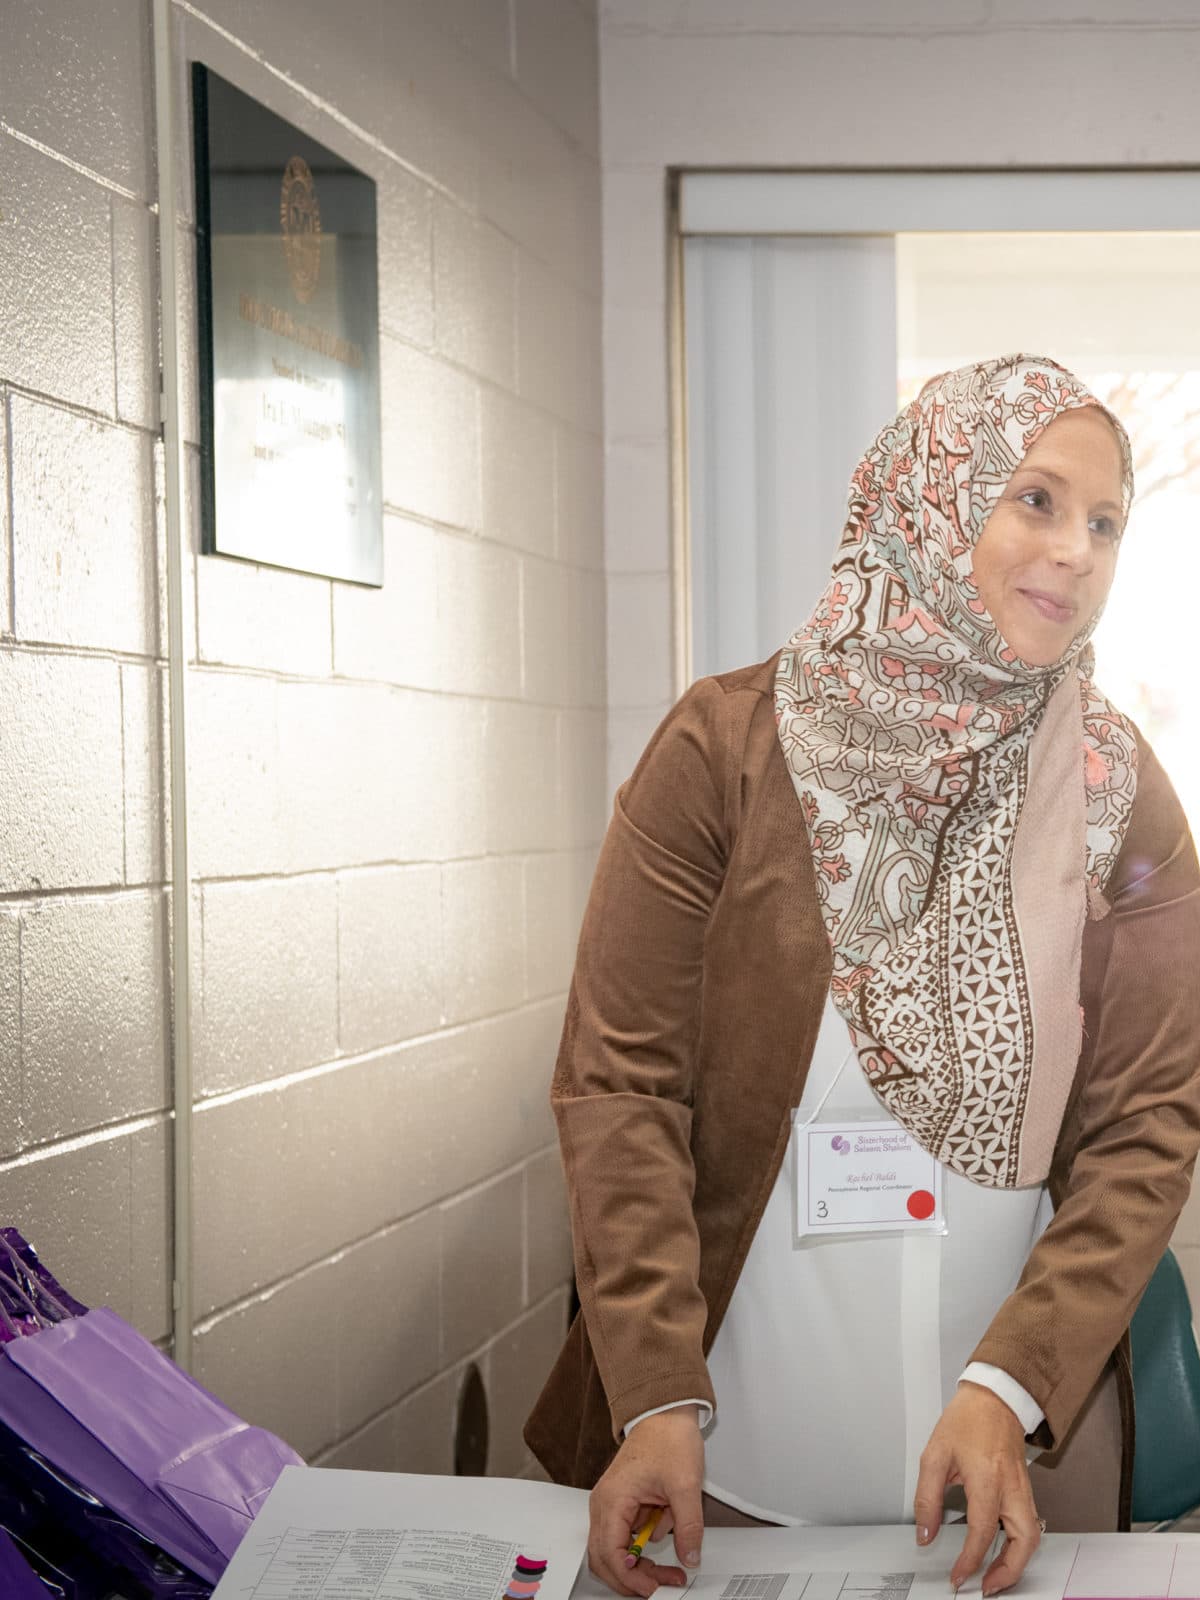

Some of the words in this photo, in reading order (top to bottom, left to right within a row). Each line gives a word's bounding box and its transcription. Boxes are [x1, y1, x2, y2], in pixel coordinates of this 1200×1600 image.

[857, 1135, 898, 1144] Sisterhood
[899, 1135, 907, 1143] of
[882, 1143, 912, 1152] Shalom
[816, 1200, 829, 1218] 3
